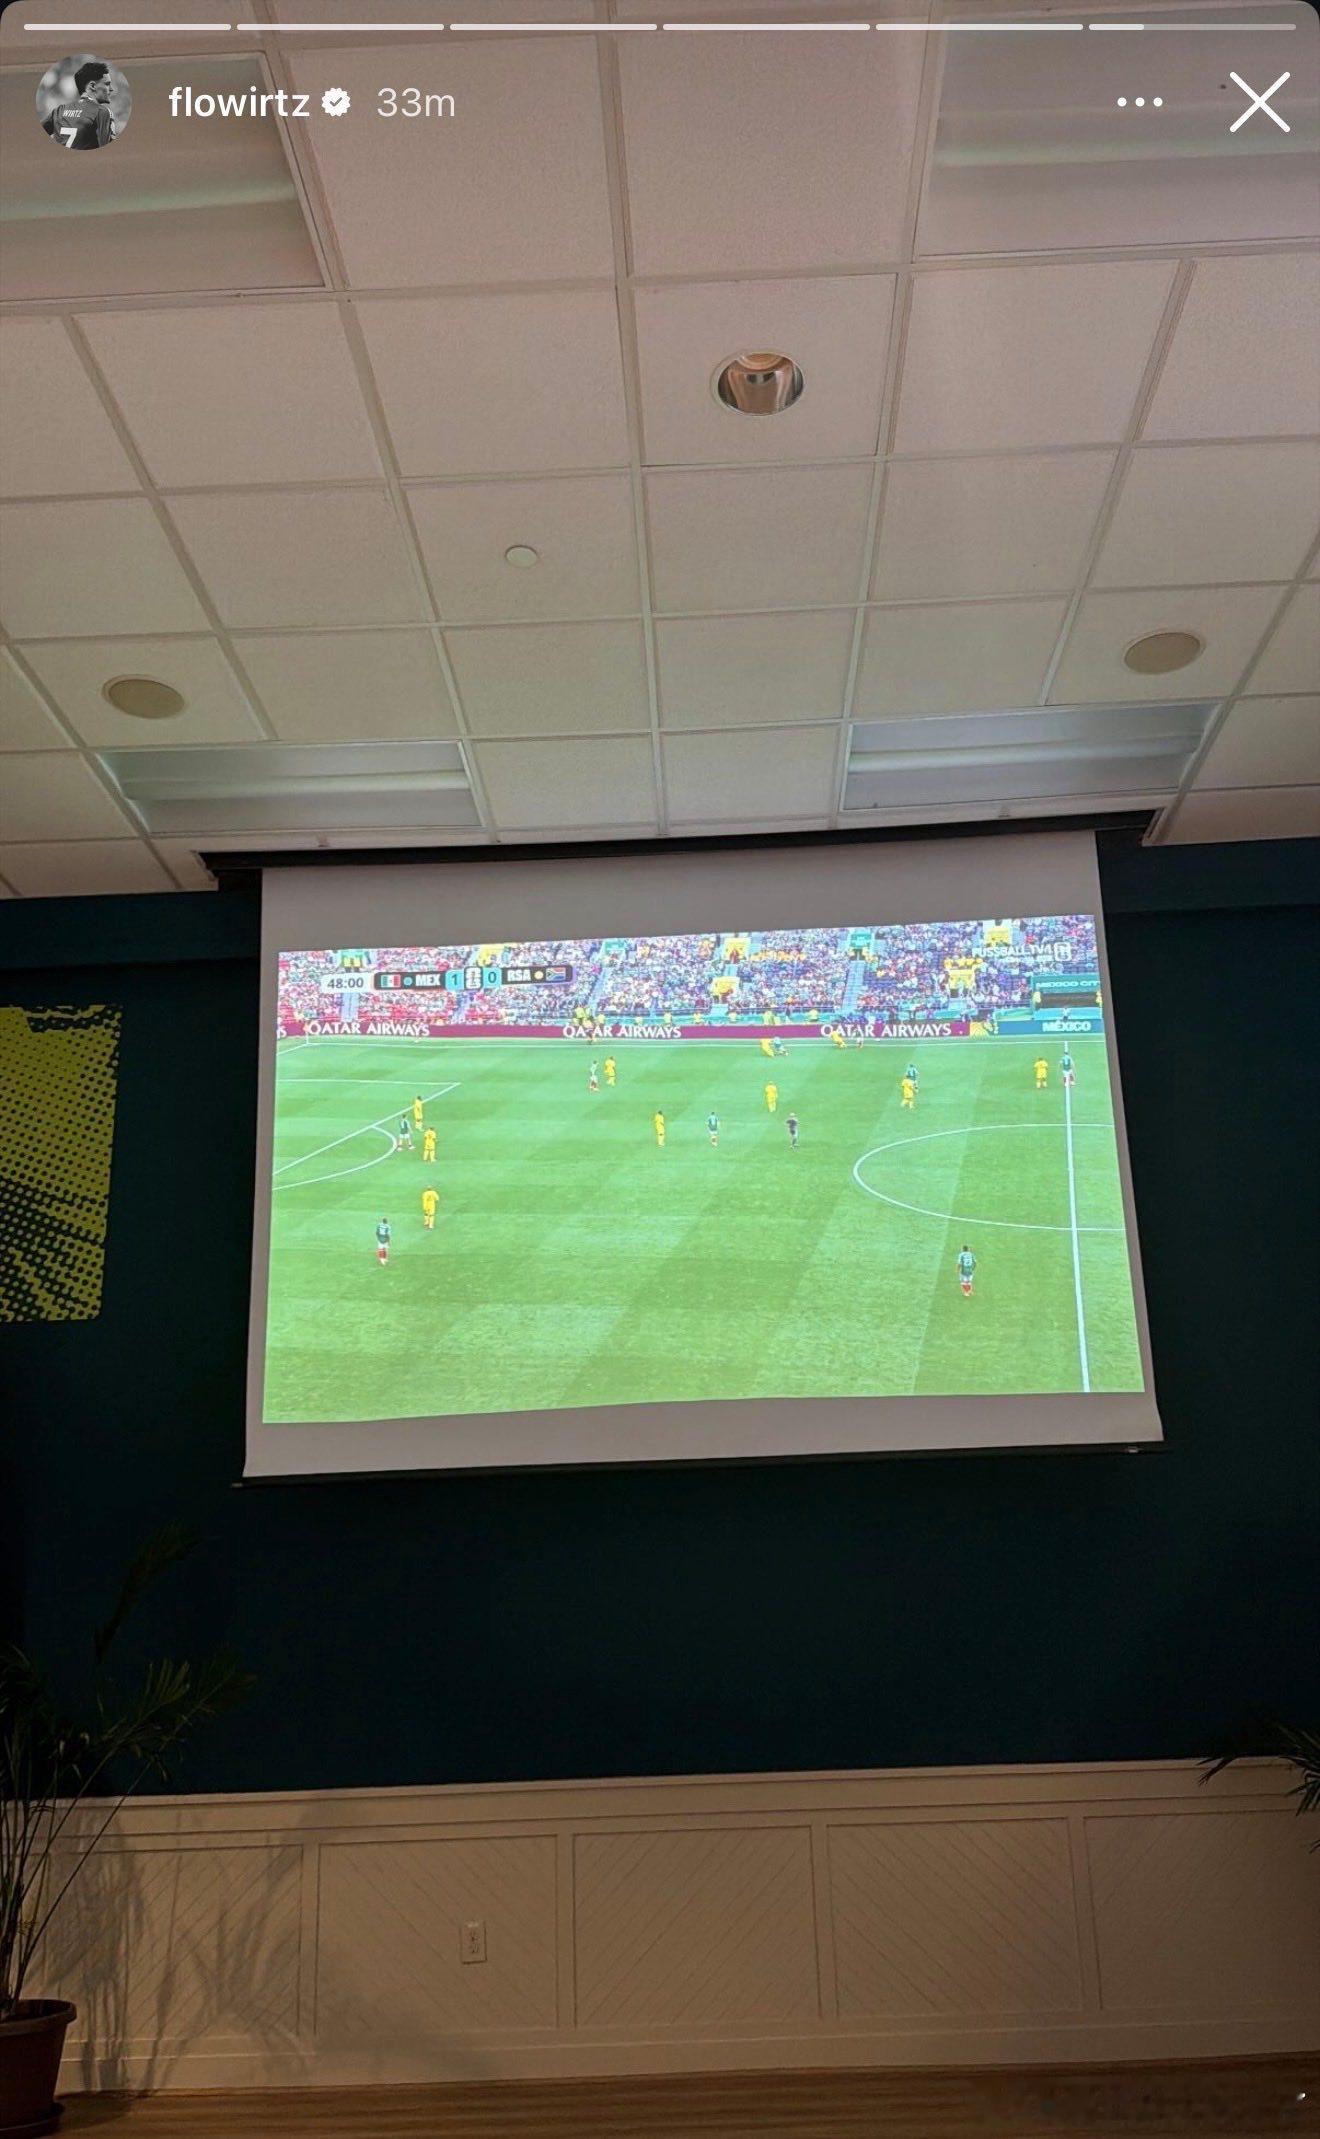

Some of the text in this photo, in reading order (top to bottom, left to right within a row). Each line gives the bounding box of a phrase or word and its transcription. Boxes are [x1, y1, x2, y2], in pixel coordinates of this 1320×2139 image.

[327, 977, 364, 989] 48:00
[415, 974, 441, 987] MEX
[451, 974, 458, 986] 1
[488, 971, 497, 984] 0
[507, 969, 532, 982] RSA
[308, 1021, 430, 1037] QATAR AIRWAYS
[562, 1024, 682, 1039] QAAR AIRWAYS
[881, 1022, 952, 1037] AIRWAYS
